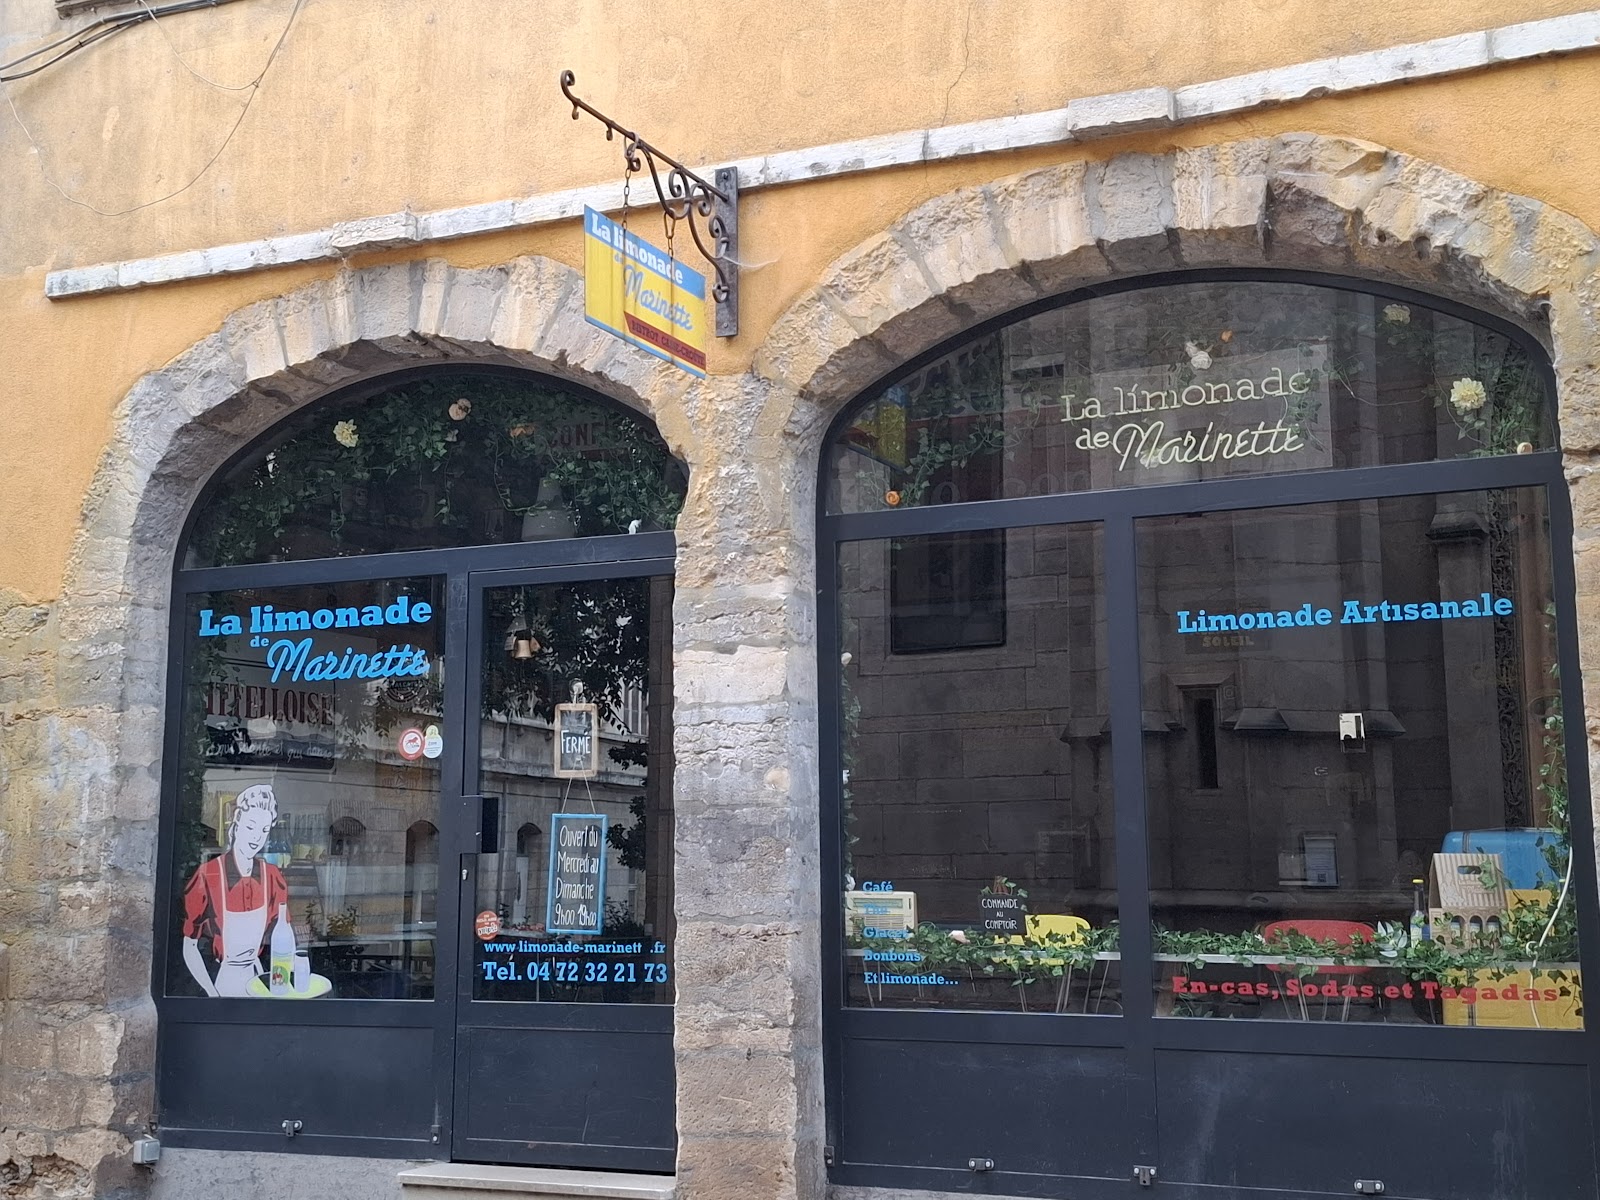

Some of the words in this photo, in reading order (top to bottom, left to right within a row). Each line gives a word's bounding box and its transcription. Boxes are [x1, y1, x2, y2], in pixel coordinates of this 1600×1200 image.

[591, 213, 612, 243] La
[613, 226, 683, 284] limonade
[624, 264, 694, 331] Marinette
[1061, 394, 1106, 422] La
[1114, 367, 1311, 416] limonade
[1076, 428, 1110, 450] de
[1112, 420, 1305, 471] Marinette
[199, 609, 242, 637] La
[250, 596, 432, 634] limonade
[1177, 604, 1333, 633] Limonade
[250, 635, 270, 648] de
[266, 638, 431, 683] Marinette
[560, 729, 591, 755] FERMÉ
[560, 825, 588, 848] Ouvert
[588, 825, 598, 848] du
[557, 850, 590, 874] Mercredi
[590, 857, 599, 874] au
[556, 877, 595, 900] Dimanche
[863, 880, 894, 893] Café
[553, 903, 576, 926] 9h00
[981, 898, 1019, 909] COMMANDE
[984, 917, 1018, 930] COMPTOIR
[527, 962, 550, 981] 04
[556, 962, 578, 982] 72
[585, 962, 607, 982] 32
[614, 963, 636, 982] 21
[644, 963, 667, 983] 73
[864, 971, 880, 984] Et
[880, 972, 959, 985] limonade...
[1172, 976, 1280, 1000] En-cas,
[1286, 978, 1374, 998] Sodas
[1384, 981, 1413, 999] et
[1421, 981, 1559, 1004] Tagadas
